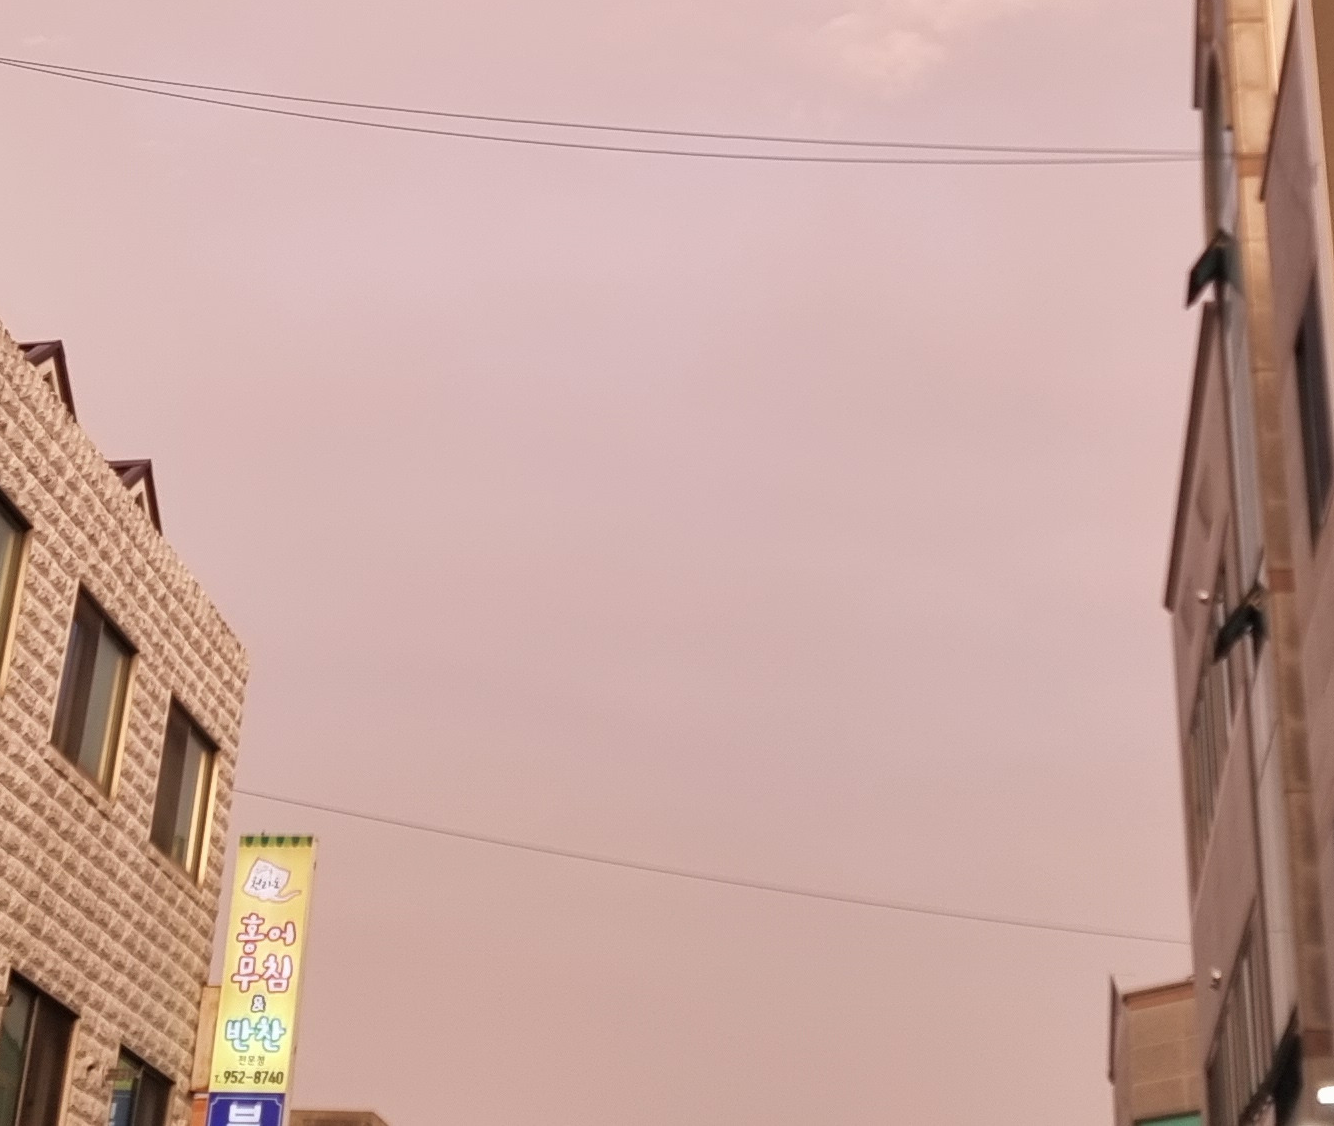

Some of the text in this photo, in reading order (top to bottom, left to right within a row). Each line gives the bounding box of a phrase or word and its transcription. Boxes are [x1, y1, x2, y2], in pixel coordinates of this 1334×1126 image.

[236, 913, 296, 955] 홍어
[230, 954, 294, 993] 무침
[251, 994, 266, 1013] &
[225, 1016, 287, 1052] 반찬
[223, 1070, 284, 1085] 952-8740
